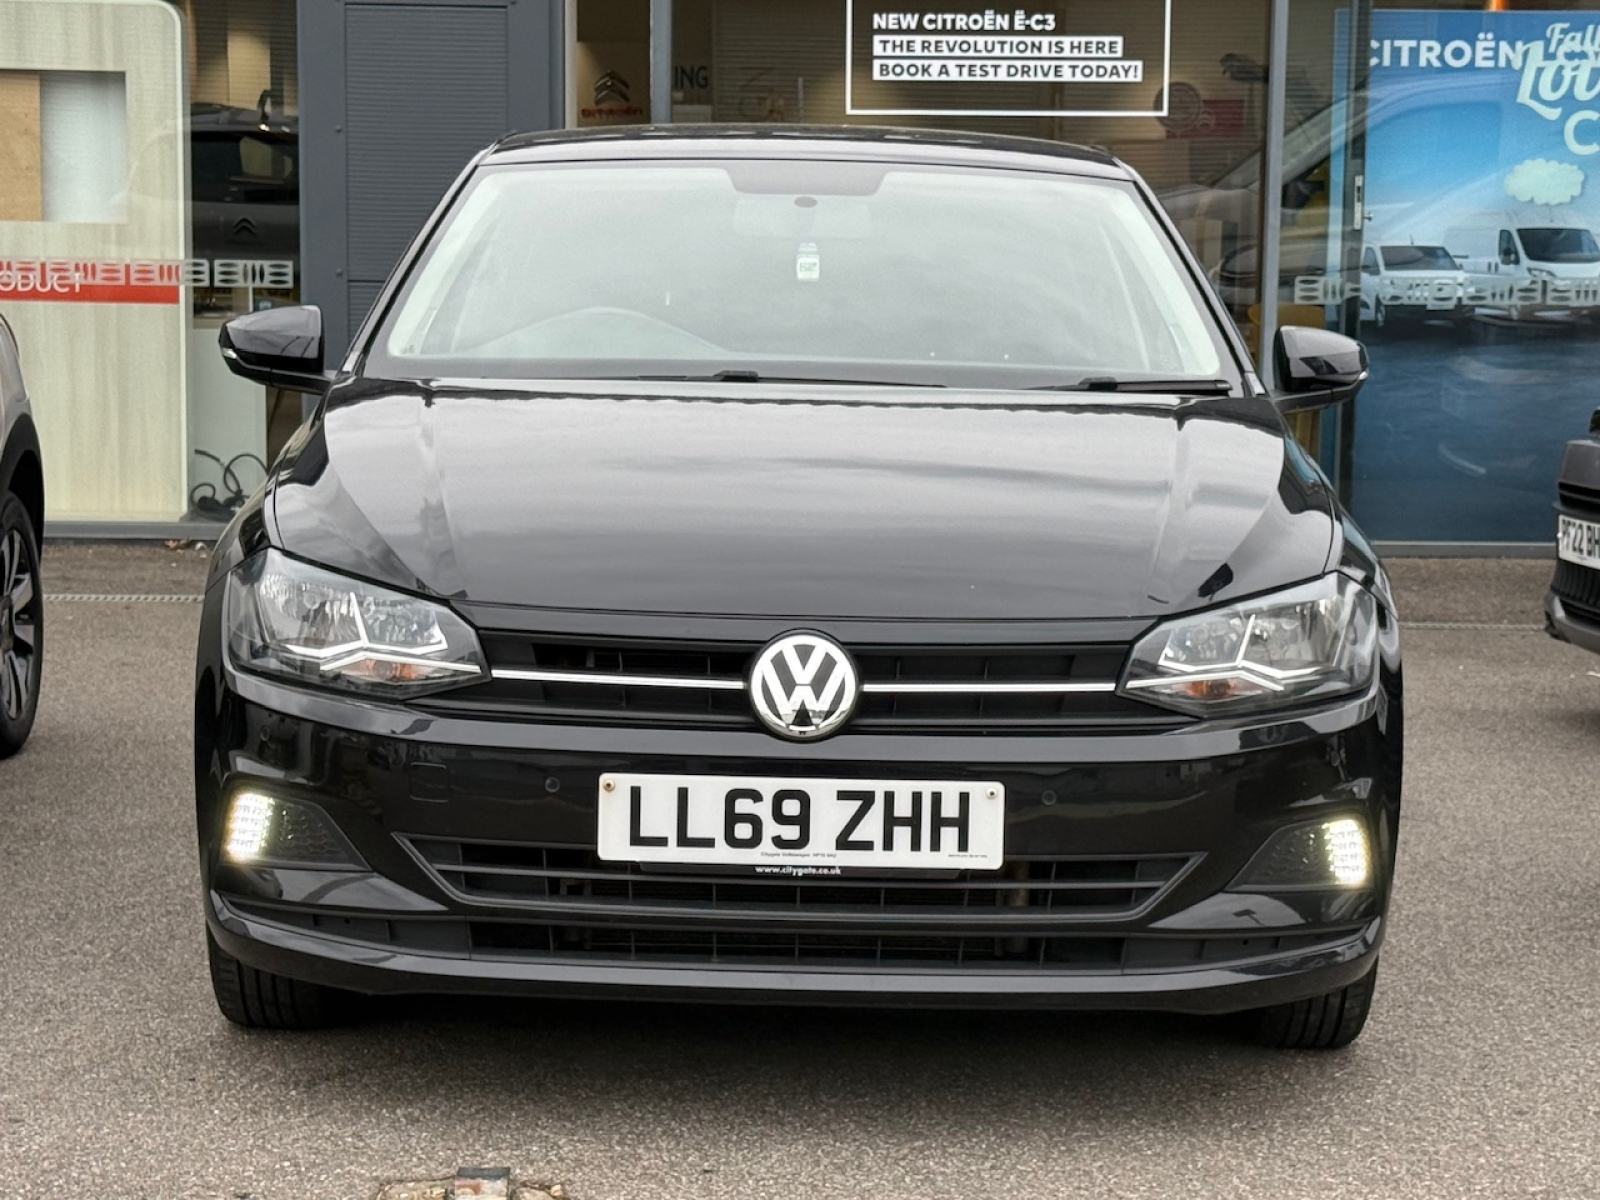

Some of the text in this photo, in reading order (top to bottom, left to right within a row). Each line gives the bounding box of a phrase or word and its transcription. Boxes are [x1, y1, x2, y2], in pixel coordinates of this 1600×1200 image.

[873, 9, 1056, 31] NEW CITROËN Ë-C3
[879, 40, 1119, 54] THE REVOLUTION IS HERE
[879, 64, 1138, 79] BOOK A TEST DRIVE TODAY!
[630, 786, 970, 853] LL69 ZHH
[755, 865, 842, 876] www.citygate.co.uk
